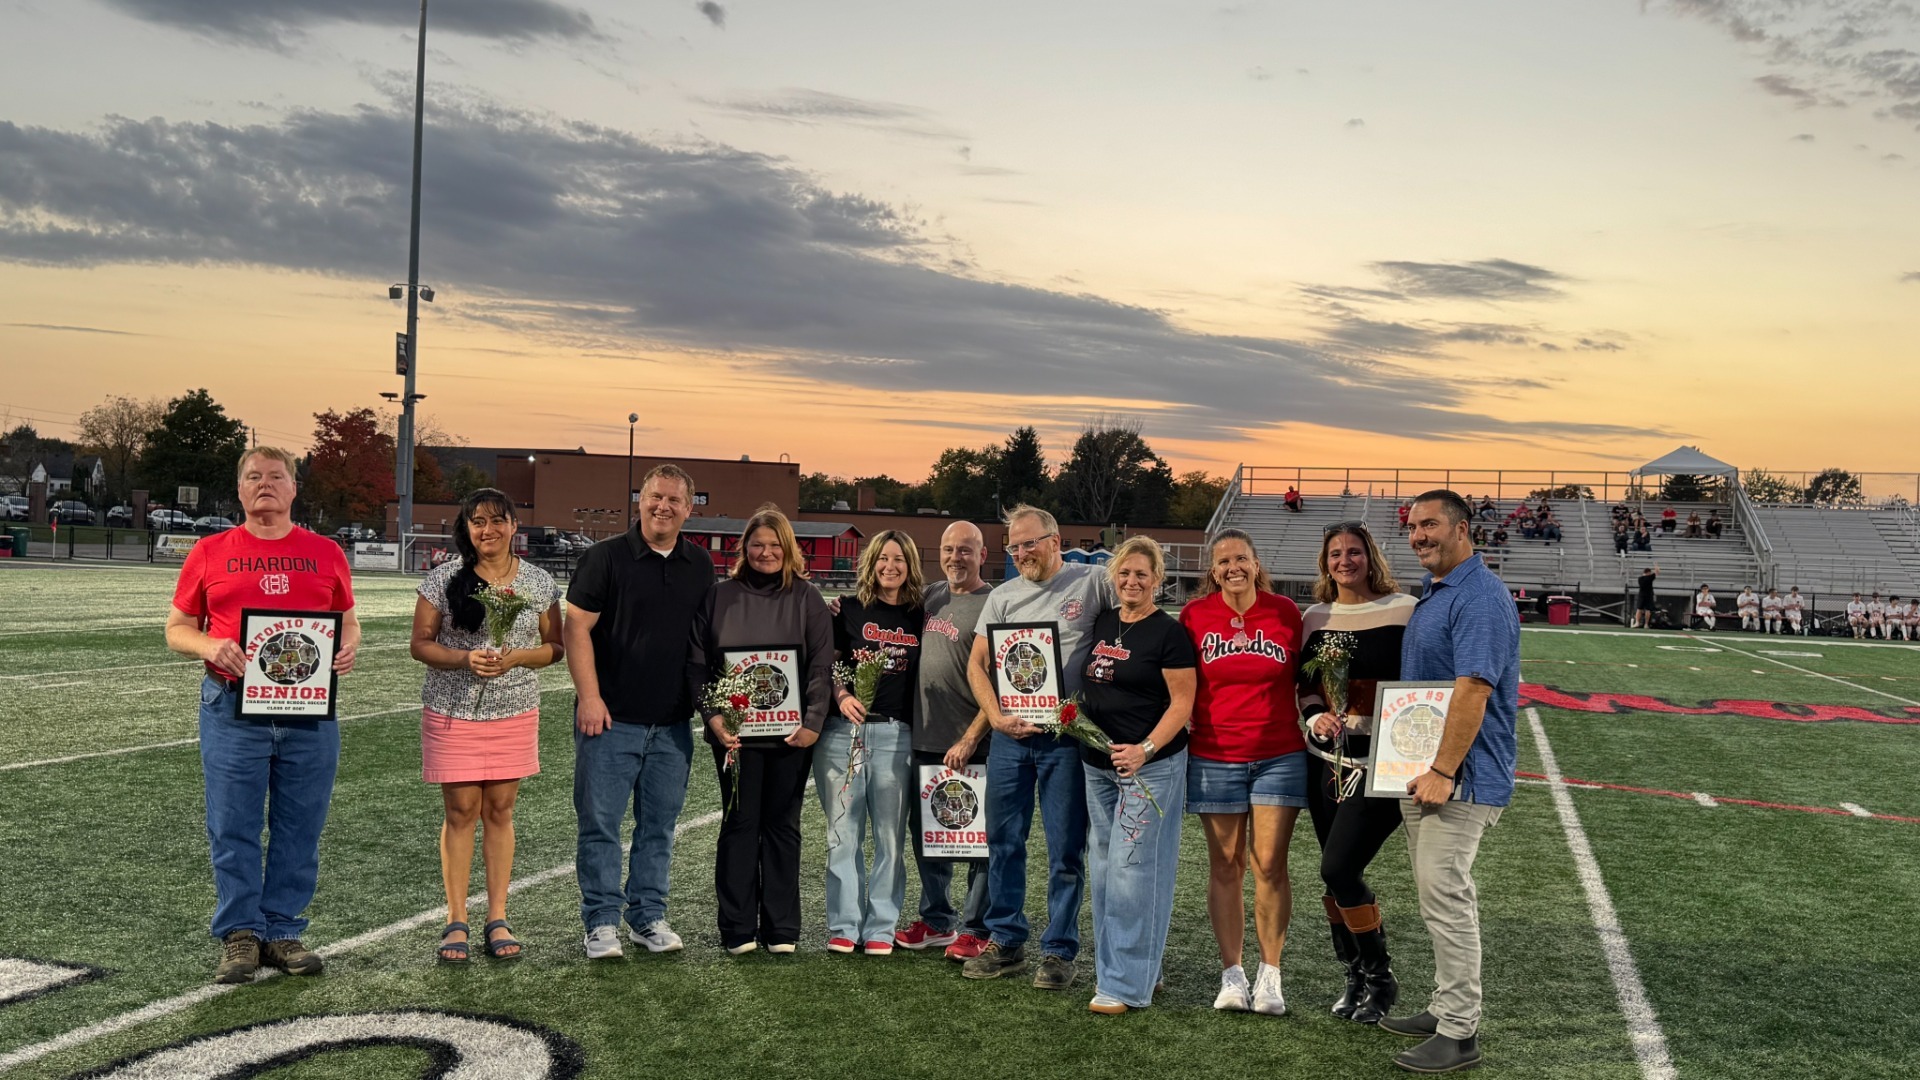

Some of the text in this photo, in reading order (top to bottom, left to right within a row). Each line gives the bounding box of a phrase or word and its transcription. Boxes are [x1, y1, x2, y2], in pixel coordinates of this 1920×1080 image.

[227, 556, 318, 574] CHARDON
[244, 618, 335, 662] ANTONIO #16
[863, 622, 919, 647] Chardon
[732, 652, 789, 675] WEN #10
[246, 685, 327, 700] SENIOR
[1426, 690, 1445, 702] #9
[1001, 695, 1057, 708] SENIOR
[745, 711, 800, 723] ENIOR
[921, 768, 954, 800] GAVIN
[924, 831, 987, 844] SENIOR
